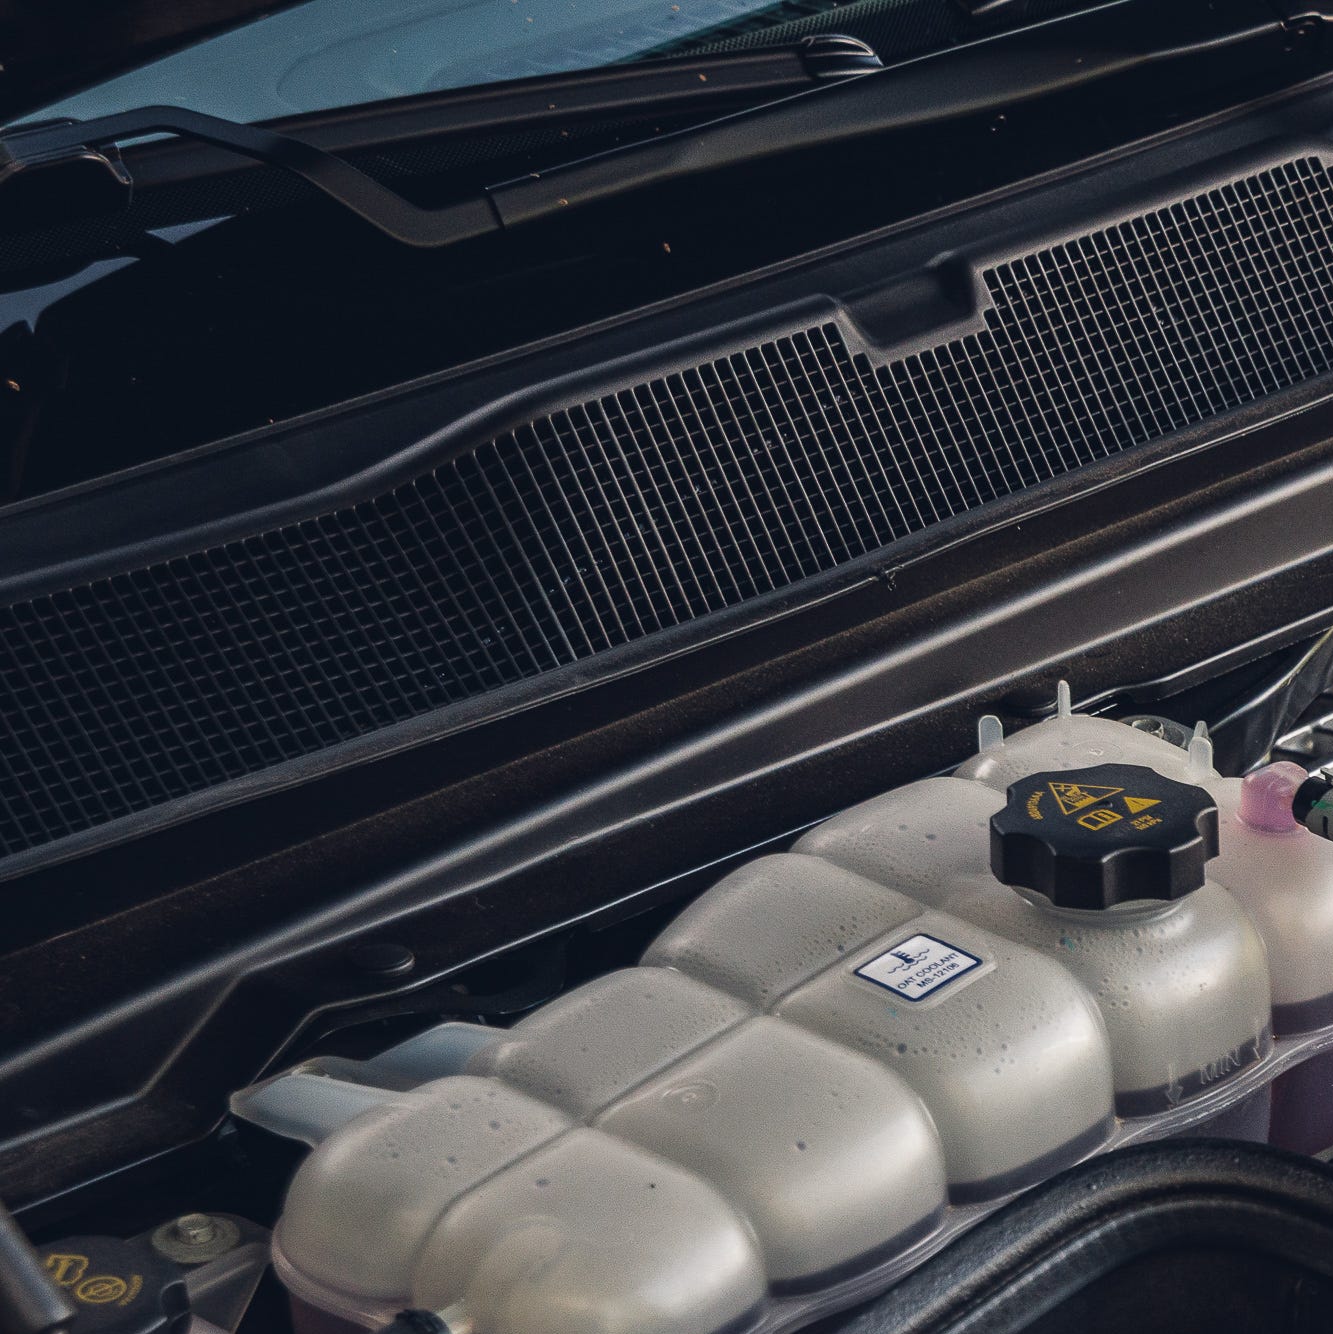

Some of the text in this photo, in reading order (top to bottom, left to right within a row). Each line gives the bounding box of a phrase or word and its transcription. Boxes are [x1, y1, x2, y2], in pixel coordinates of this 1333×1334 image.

[897, 952, 959, 990] OAT COOLANT
[1200, 1048, 1241, 1085] MIN
